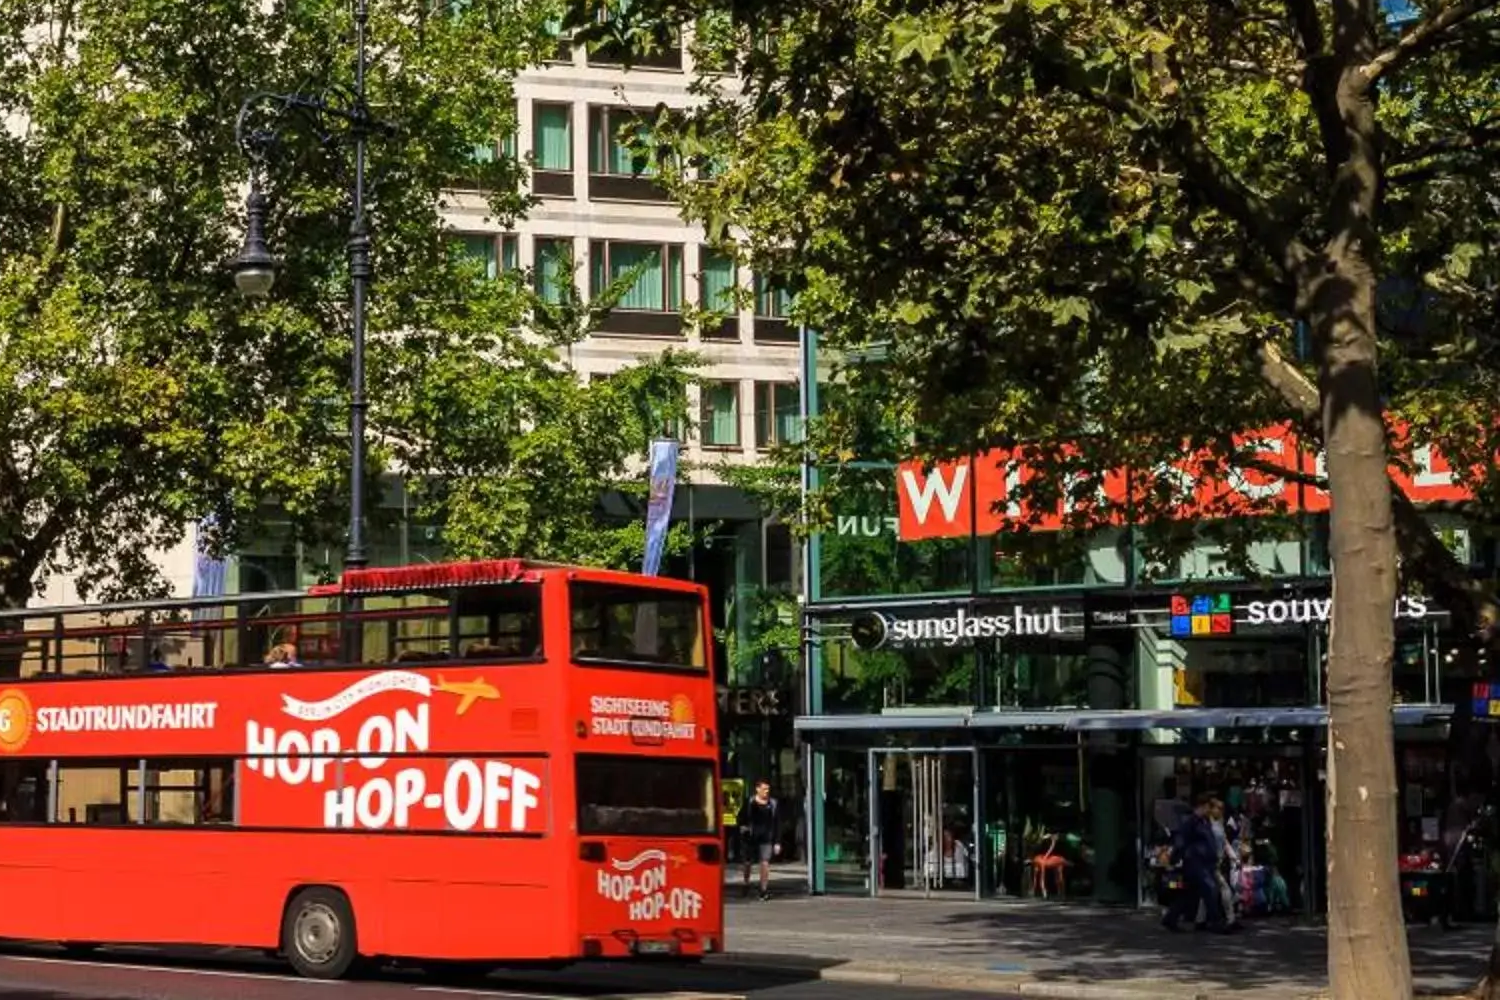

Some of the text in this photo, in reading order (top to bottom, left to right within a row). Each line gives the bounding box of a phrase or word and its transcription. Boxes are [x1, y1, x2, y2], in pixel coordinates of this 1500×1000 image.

[893, 605, 1064, 646] sunglass hut
[35, 701, 218, 733] STADTRUNDFAHRT
[590, 695, 671, 718] SIGHTSEEING
[245, 701, 430, 785] HOP-ON
[591, 716, 696, 740] STADTRUNDFAHRT
[323, 758, 541, 831] HOP-OFF
[597, 865, 667, 902] HOP-ON
[629, 887, 704, 921] HOP-OFF
